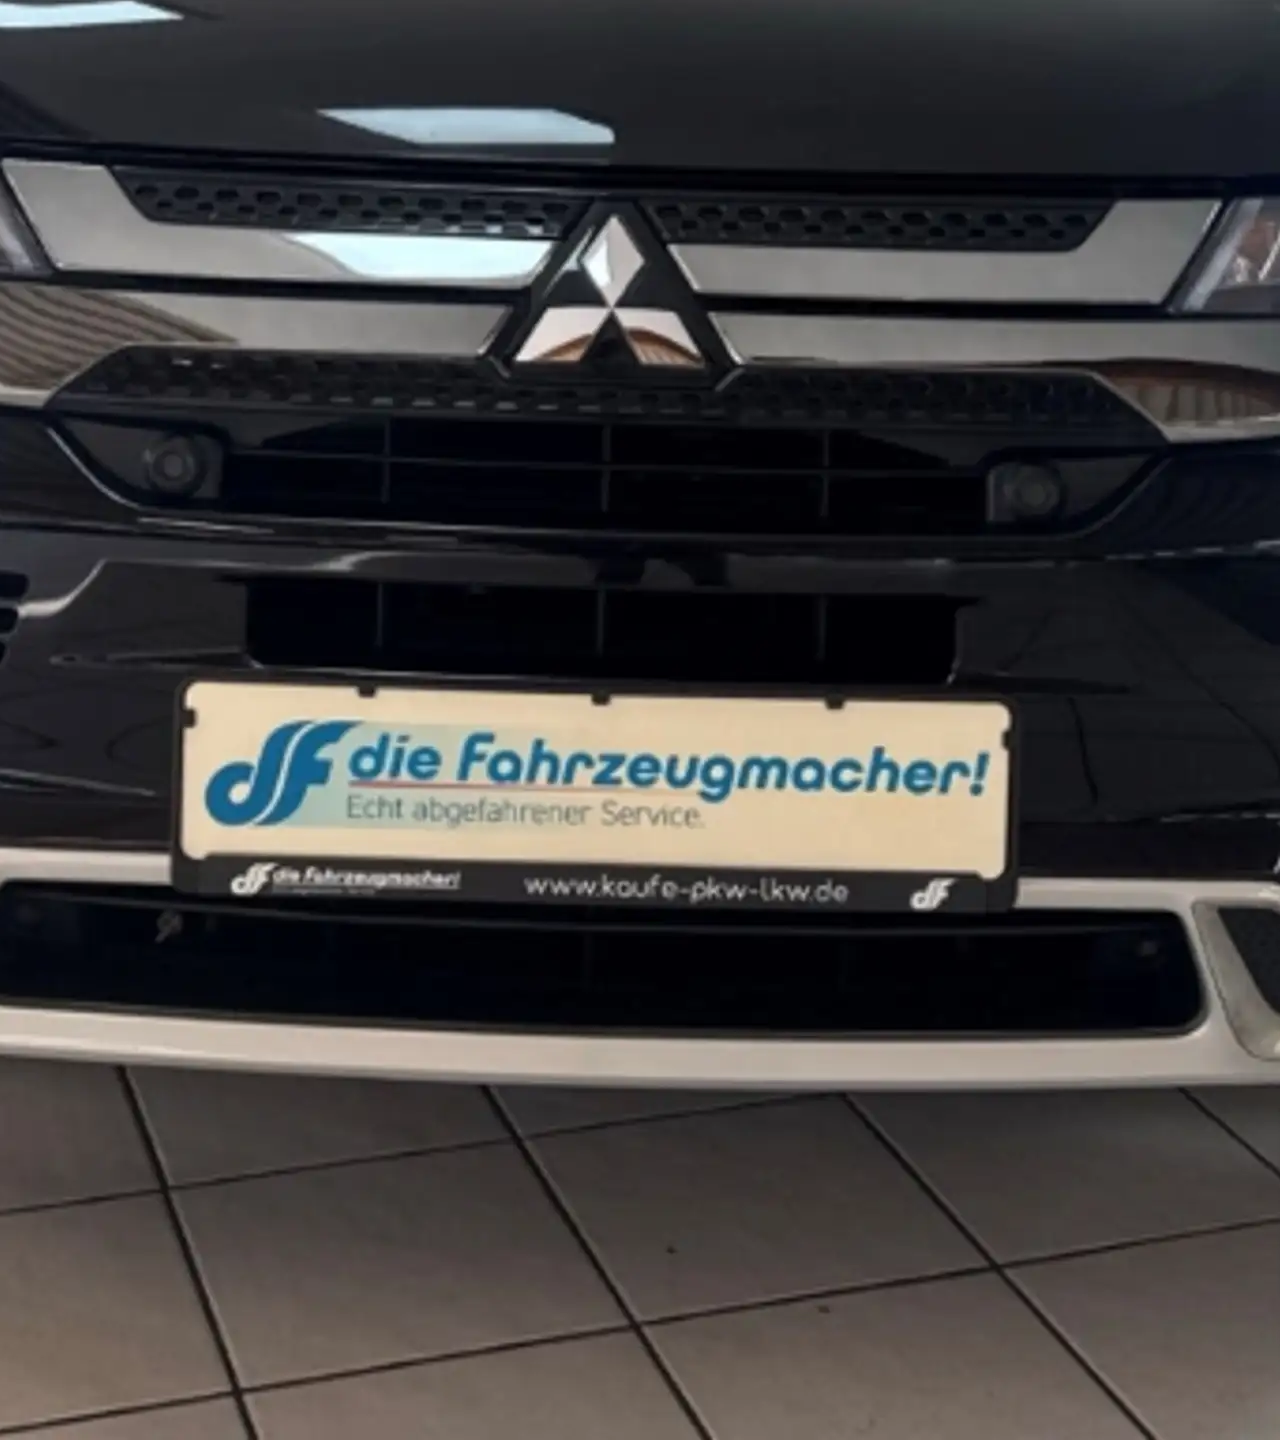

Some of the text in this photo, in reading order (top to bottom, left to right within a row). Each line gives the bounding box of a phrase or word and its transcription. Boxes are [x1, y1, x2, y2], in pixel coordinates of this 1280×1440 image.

[348, 731, 990, 804] die Fahrzeugmacher!
[346, 793, 706, 830] Echt abgefahrener Service.
[522, 873, 850, 906] www.kaufe-pkw-lkw.de
